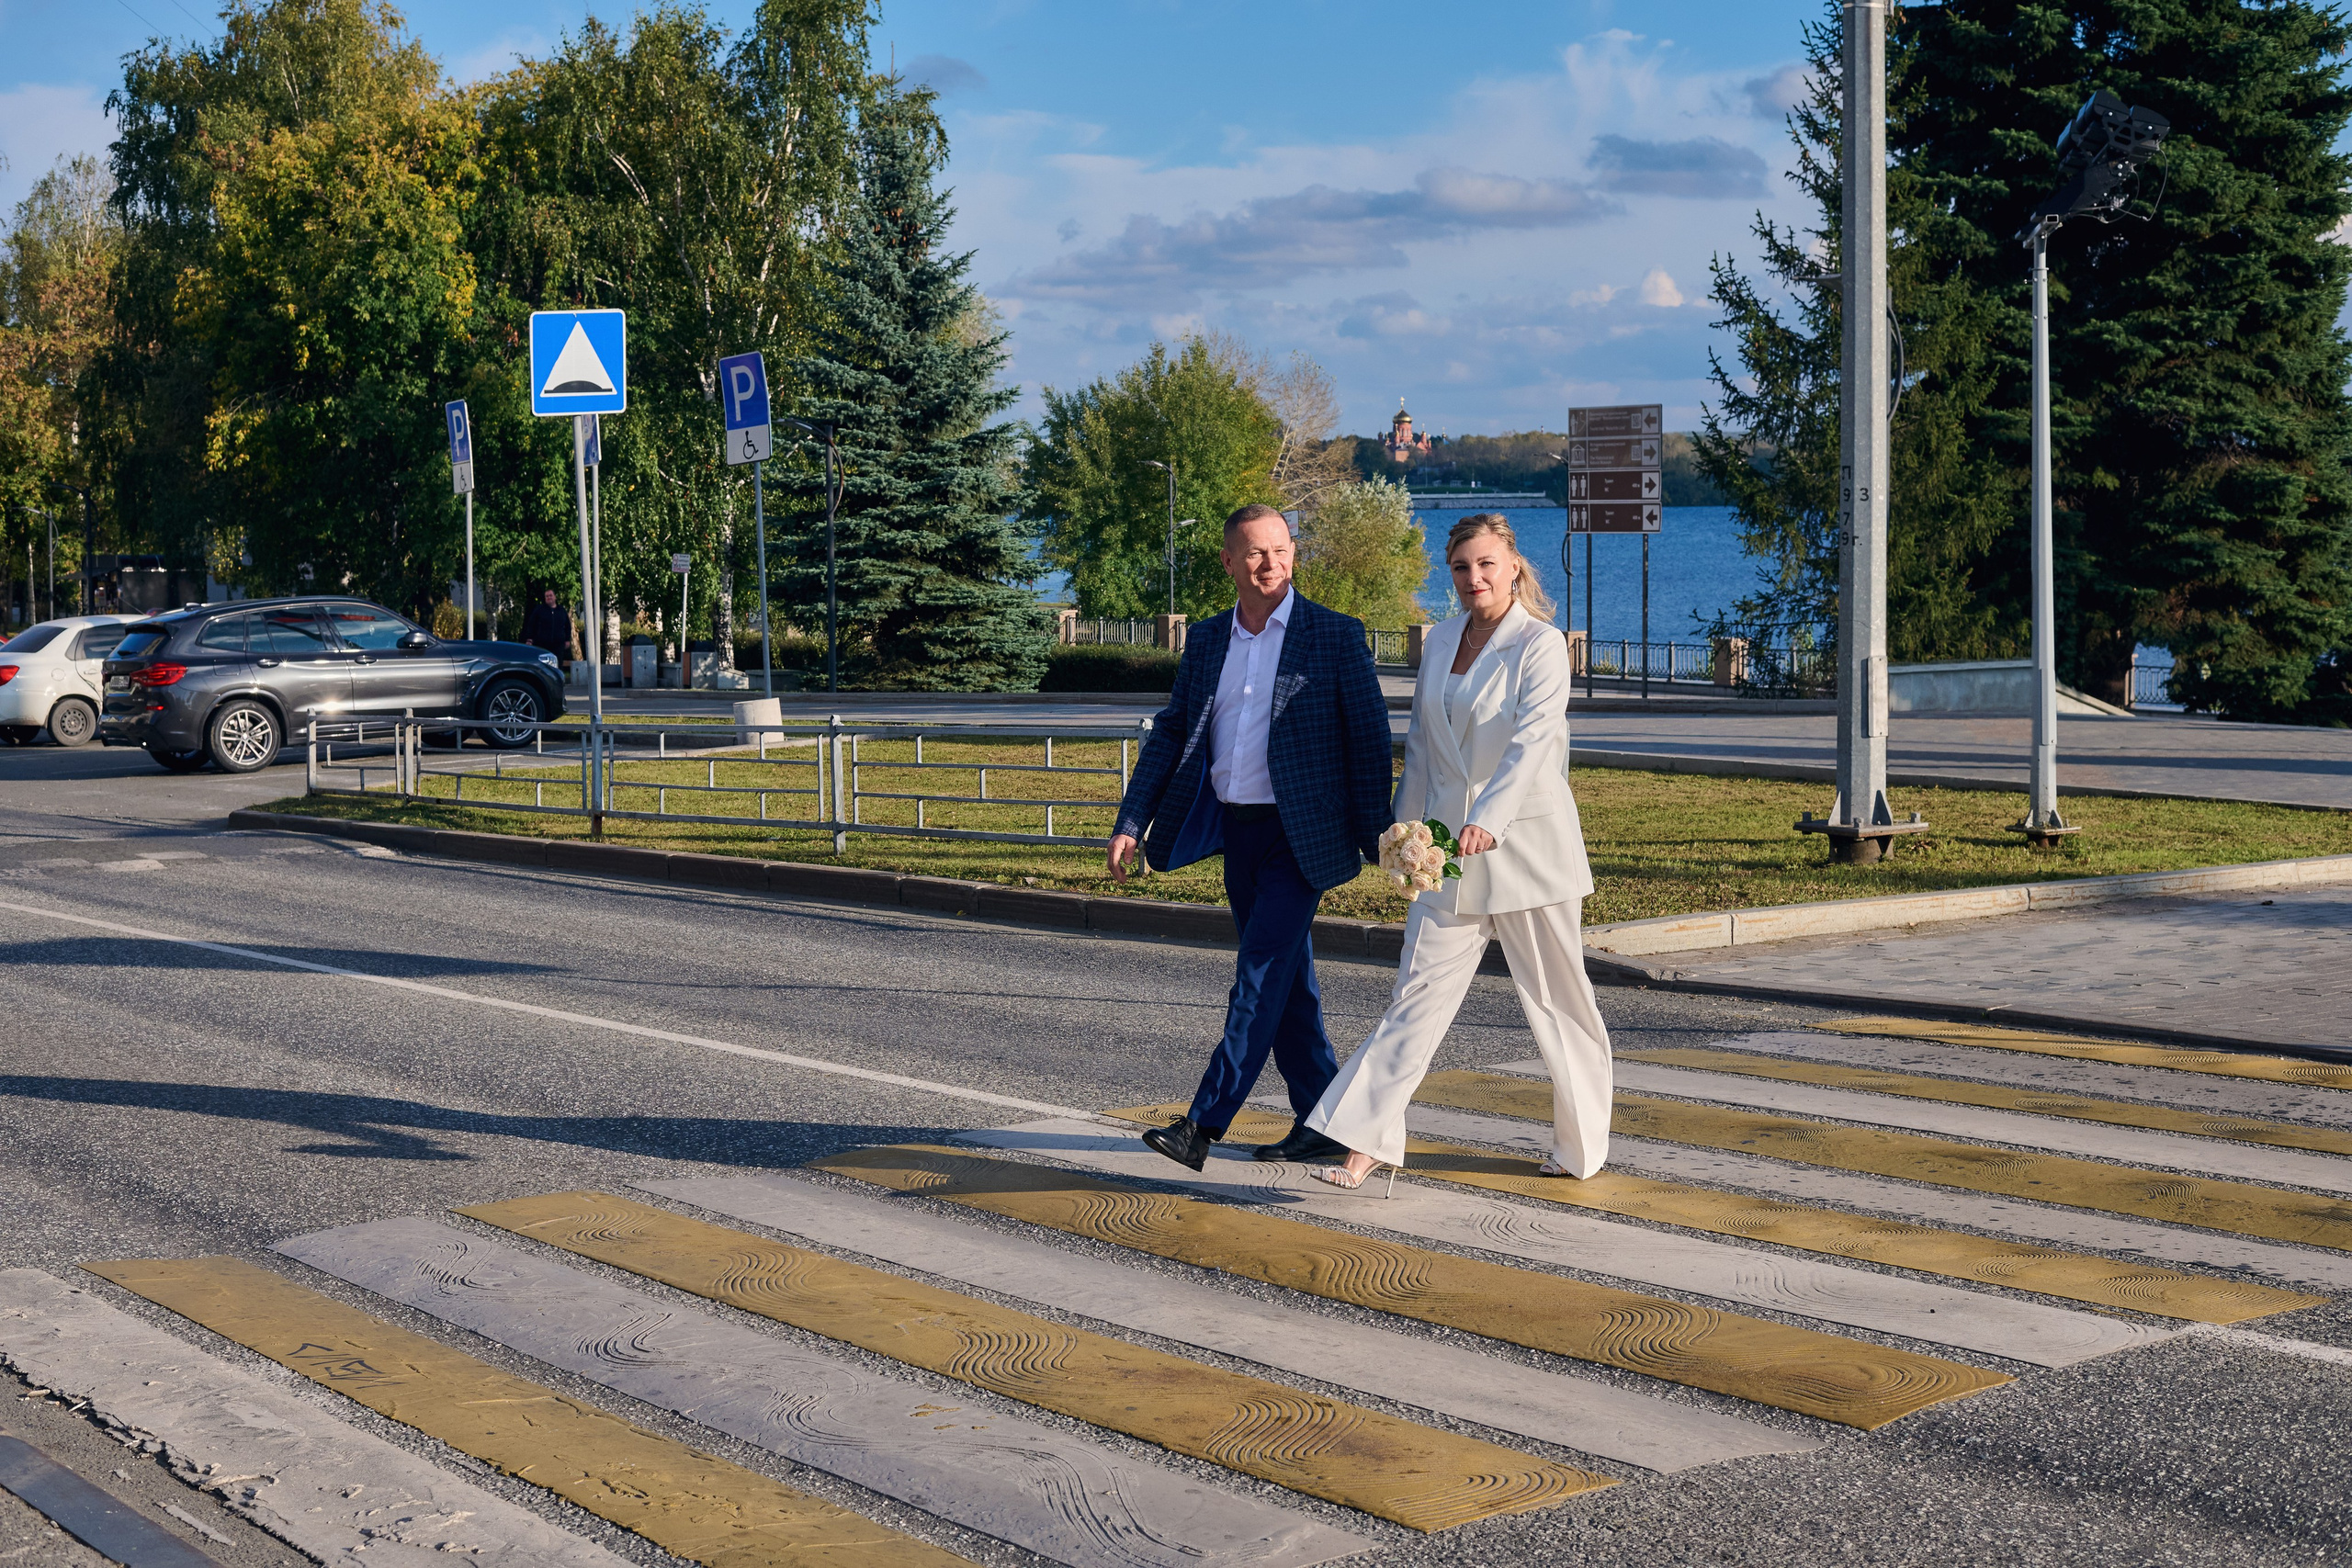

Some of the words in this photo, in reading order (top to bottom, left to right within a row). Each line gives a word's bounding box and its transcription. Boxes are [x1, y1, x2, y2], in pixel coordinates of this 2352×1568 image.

[729, 365, 756, 422] P
[451, 409, 465, 457] P
[1841, 466, 1851, 480] П
